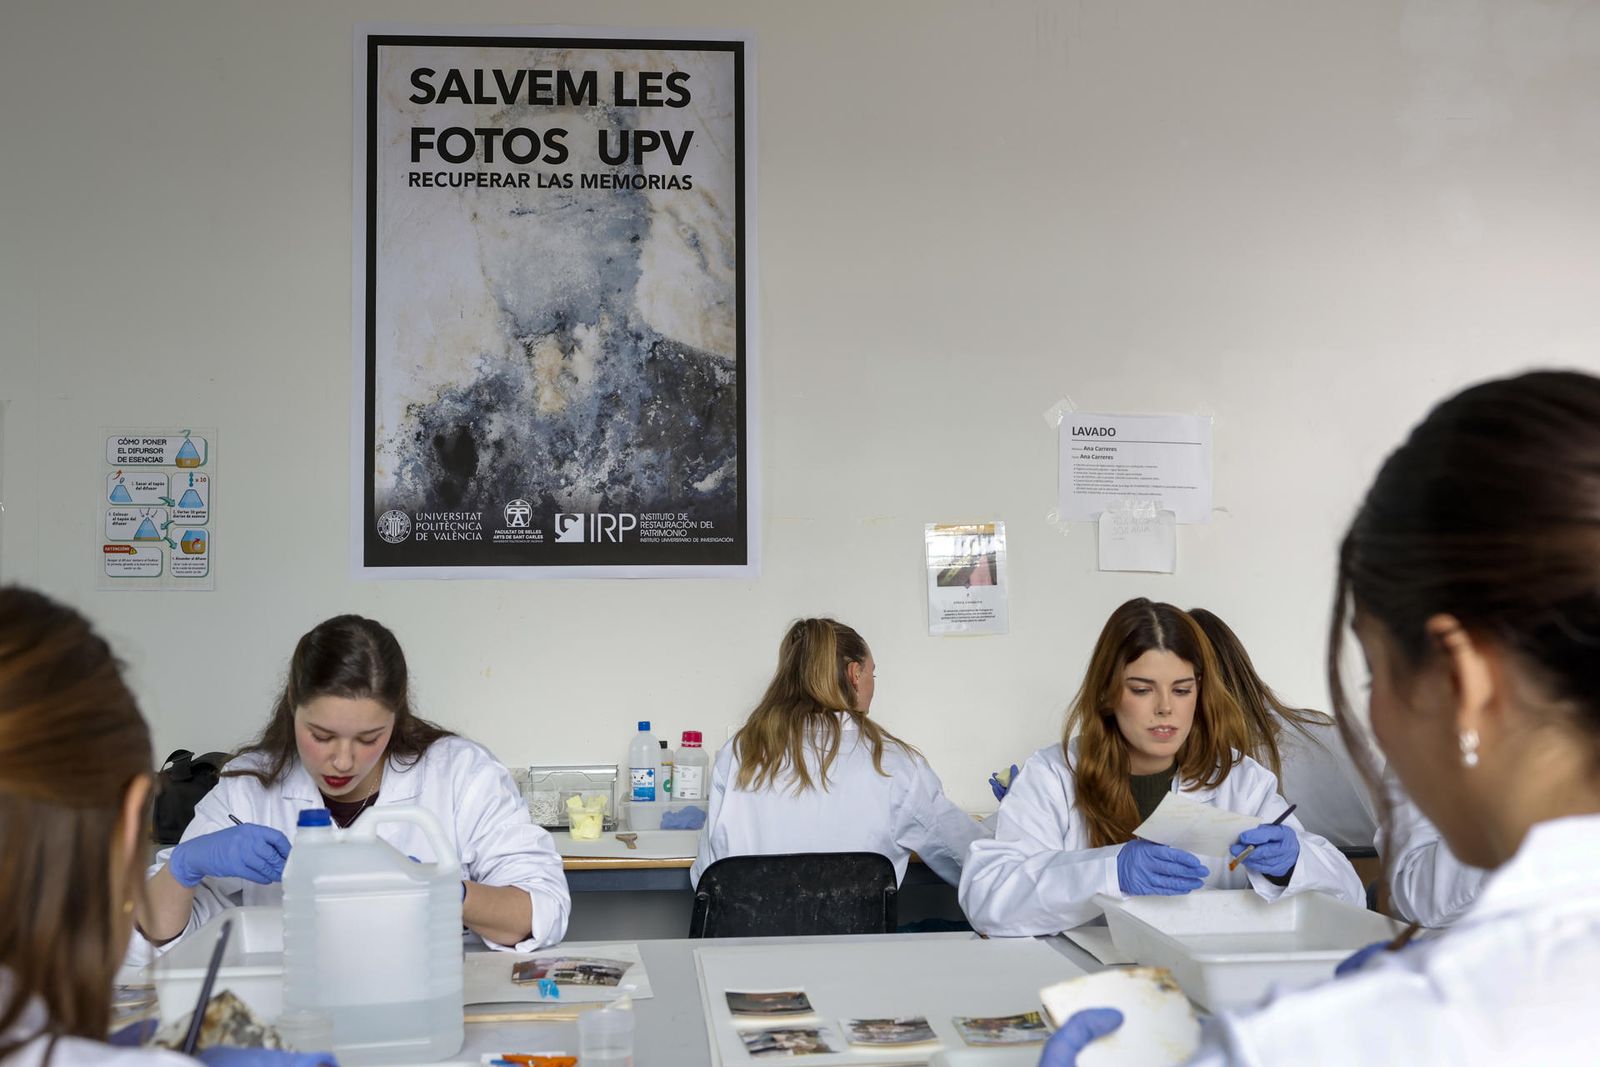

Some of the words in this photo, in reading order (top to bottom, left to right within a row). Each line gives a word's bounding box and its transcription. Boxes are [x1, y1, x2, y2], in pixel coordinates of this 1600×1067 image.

[409, 67, 597, 106] SALVEM
[614, 71, 691, 108] LES
[411, 127, 569, 165] FOTOS
[599, 130, 694, 165] UPV
[408, 172, 530, 188] RECUPERAR
[538, 173, 573, 189] LAS
[581, 174, 692, 190] MEMORIAS
[1072, 426, 1116, 437] LAVADO
[117, 437, 140, 445] CÓMO
[416, 512, 482, 521] UNIVERSITAT
[640, 512, 674, 521] INSTITUTO
[678, 513, 688, 521] DE
[416, 521, 482, 531] POLITÈCNICA
[590, 513, 637, 543] IRP
[640, 519, 697, 529] RESTAURACIÓN
[700, 520, 715, 529] DEL
[416, 533, 428, 541] DE
[434, 531, 482, 541] VALÈNCIA
[640, 528, 688, 537] PATRIMONIO
